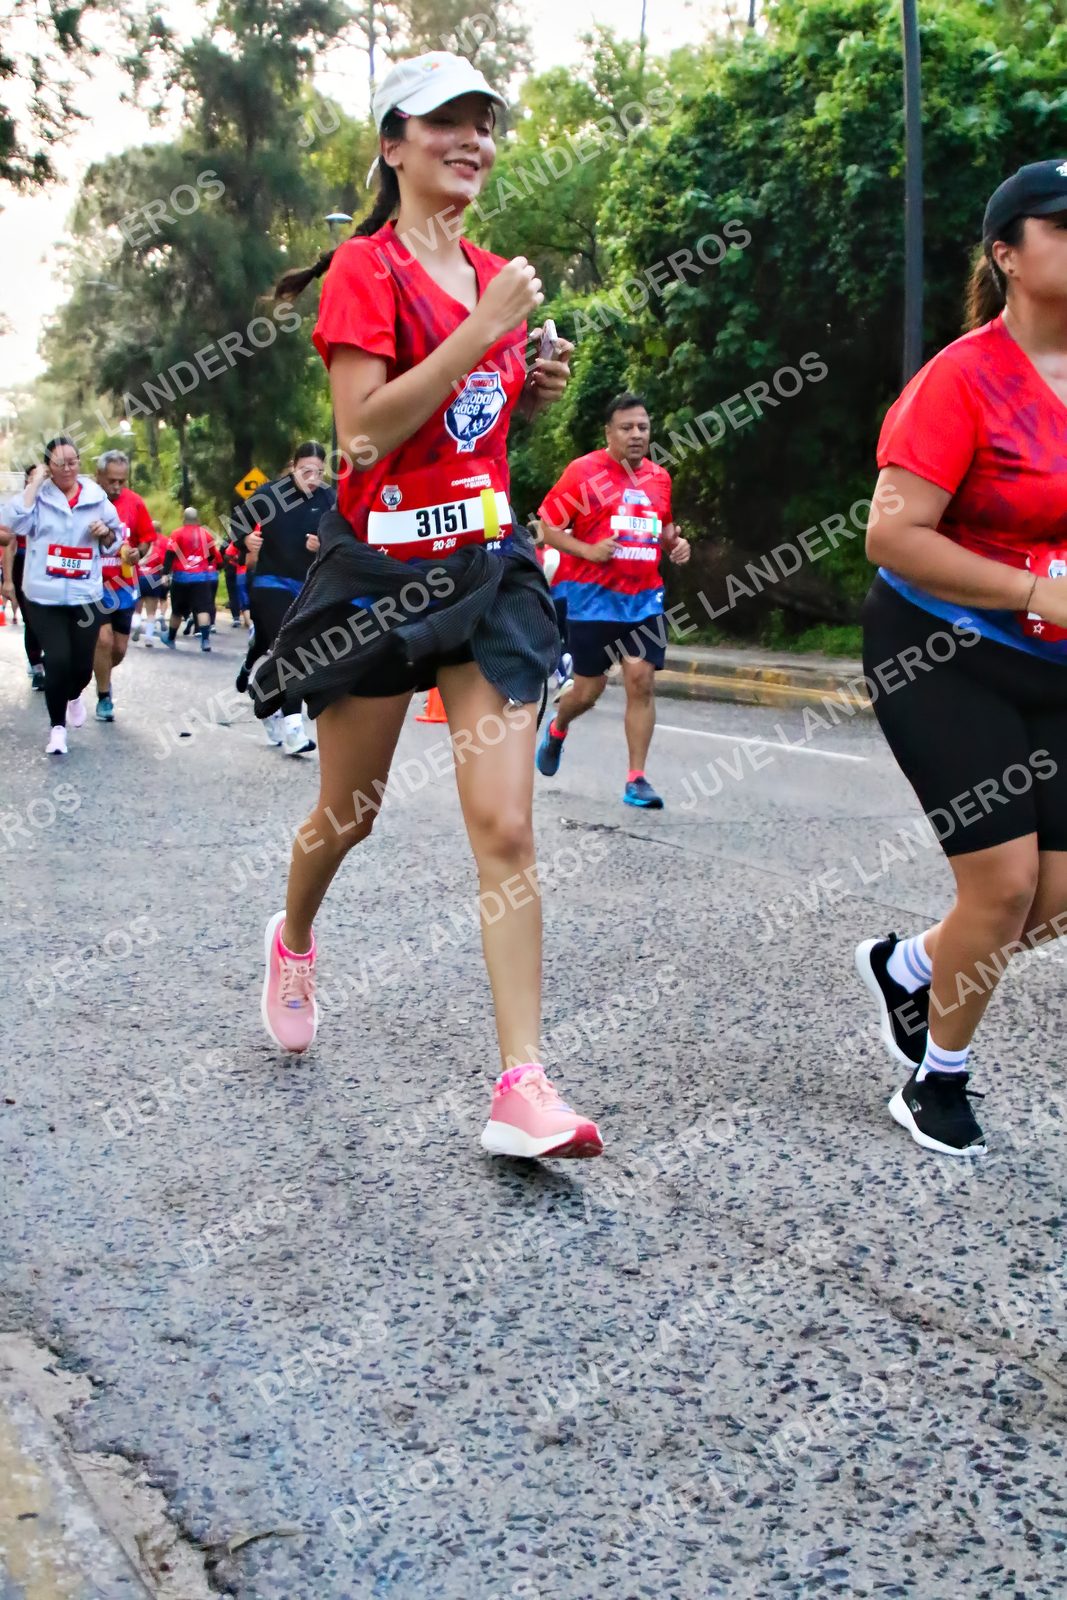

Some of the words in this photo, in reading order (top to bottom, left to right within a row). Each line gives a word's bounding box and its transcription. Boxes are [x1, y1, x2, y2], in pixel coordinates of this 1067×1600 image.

[416, 503, 468, 538] 3151
[629, 518, 647, 529] 1673
[613, 546, 657, 561] ANTIAGO
[61, 558, 82, 569] 3458
